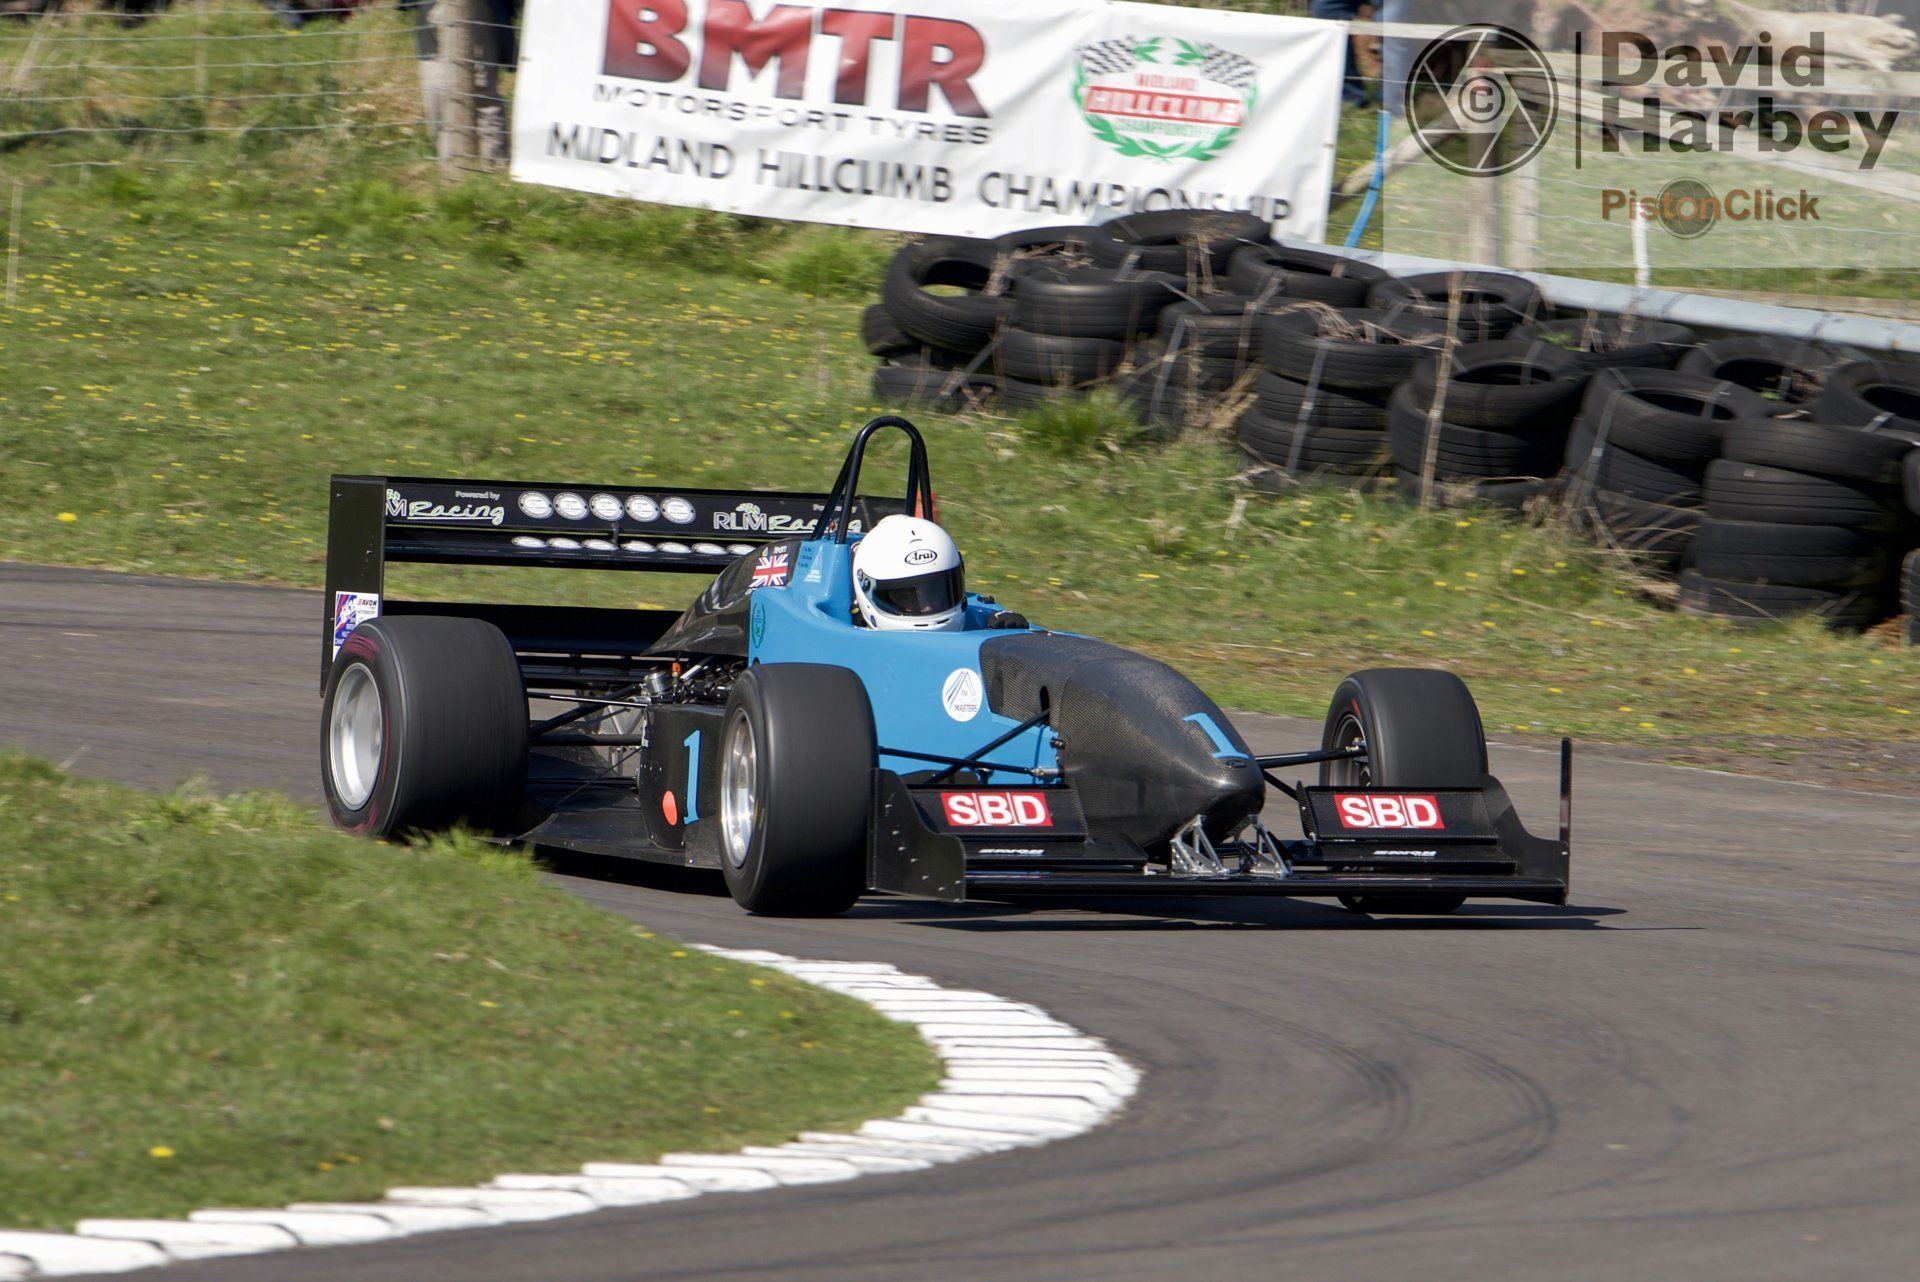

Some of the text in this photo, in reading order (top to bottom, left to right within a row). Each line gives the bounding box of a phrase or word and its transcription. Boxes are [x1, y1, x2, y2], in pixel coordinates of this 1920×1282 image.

[602, 0, 991, 119] BMTR
[594, 83, 994, 146] MOTORSPORT TYRES
[547, 121, 736, 180] MIDLAND
[756, 147, 955, 204] HILLCLIMB
[455, 490, 501, 501] Powered by
[408, 501, 505, 526] Racing
[713, 511, 767, 531] RLM
[912, 551, 934, 561] Arai
[1182, 712, 1250, 759] 1
[683, 729, 701, 826] 1
[947, 794, 1047, 826] SBD
[1341, 796, 1438, 828] SBD
